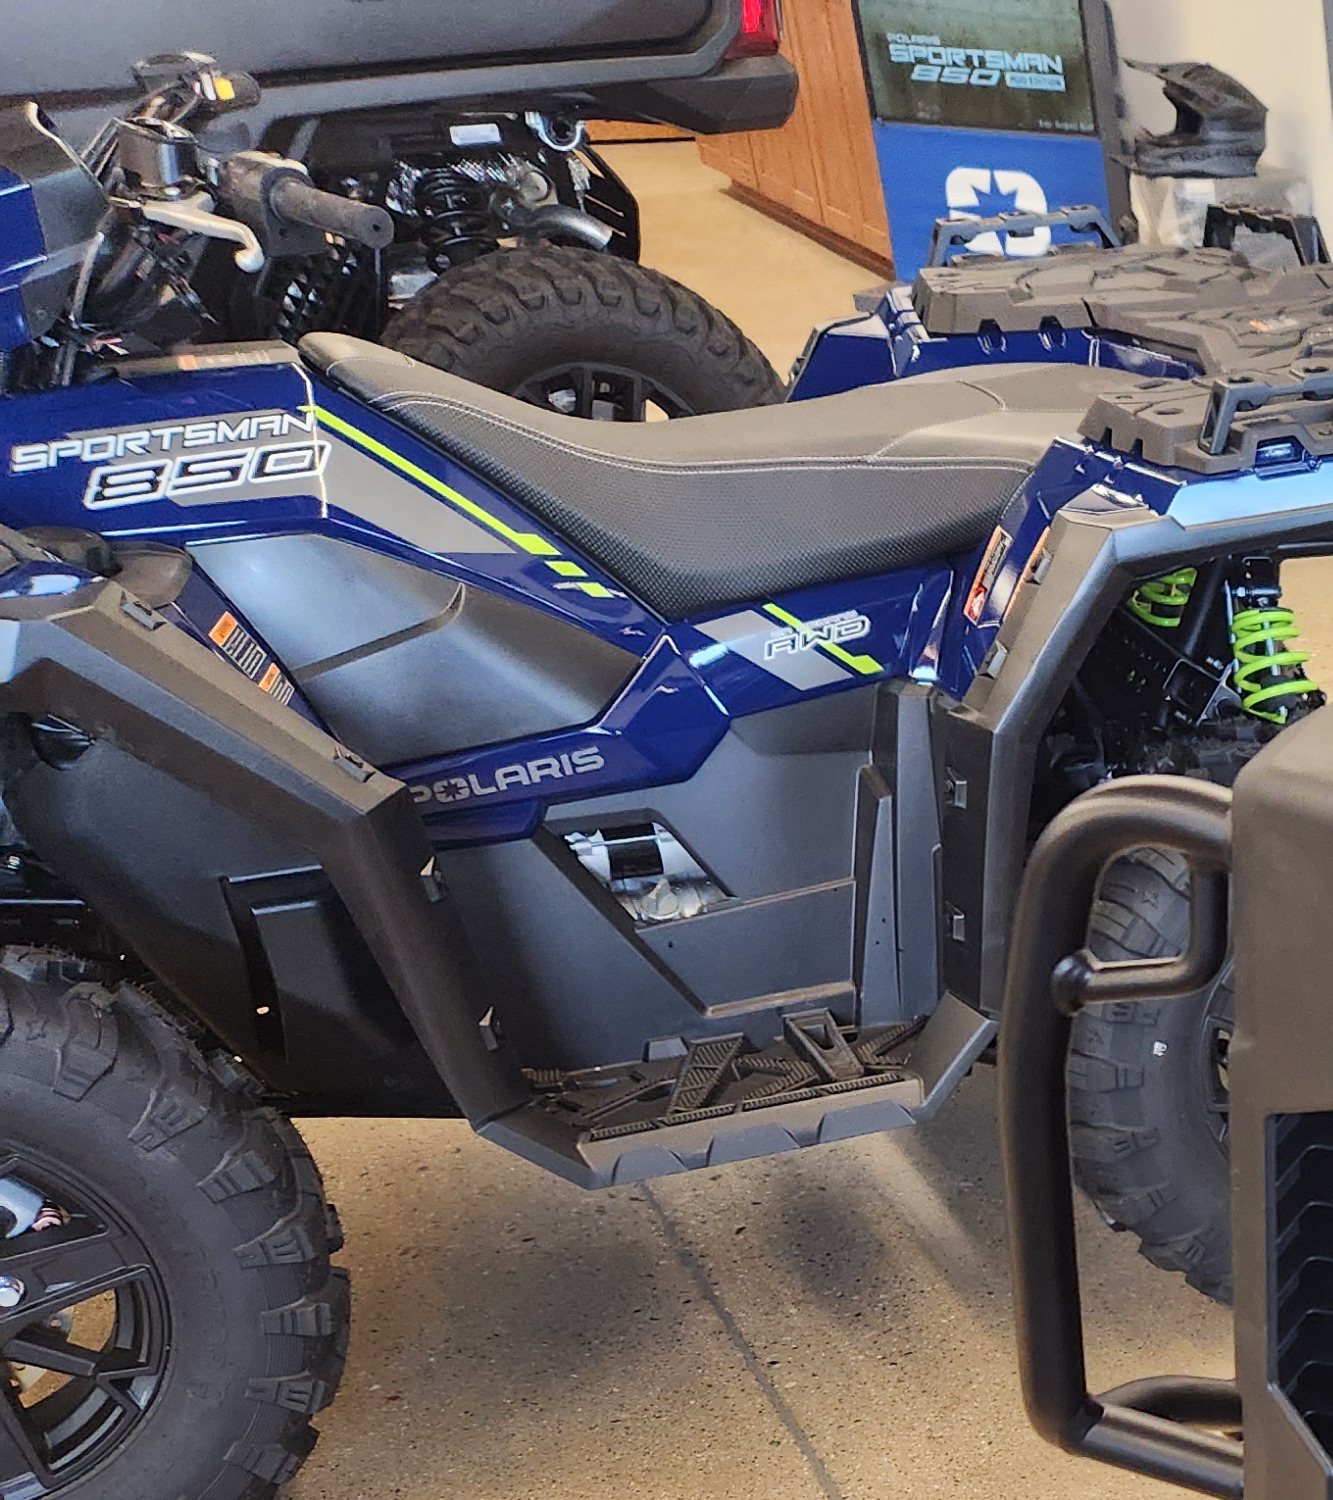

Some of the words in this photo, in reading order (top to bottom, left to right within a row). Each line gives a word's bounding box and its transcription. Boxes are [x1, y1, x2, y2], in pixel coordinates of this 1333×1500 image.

[888, 44, 1064, 75] SPORTSMAN
[10, 411, 314, 474] SPORTSMAN
[83, 440, 333, 511] 850
[764, 614, 871, 660] AWD
[409, 746, 605, 804] POLARIS
